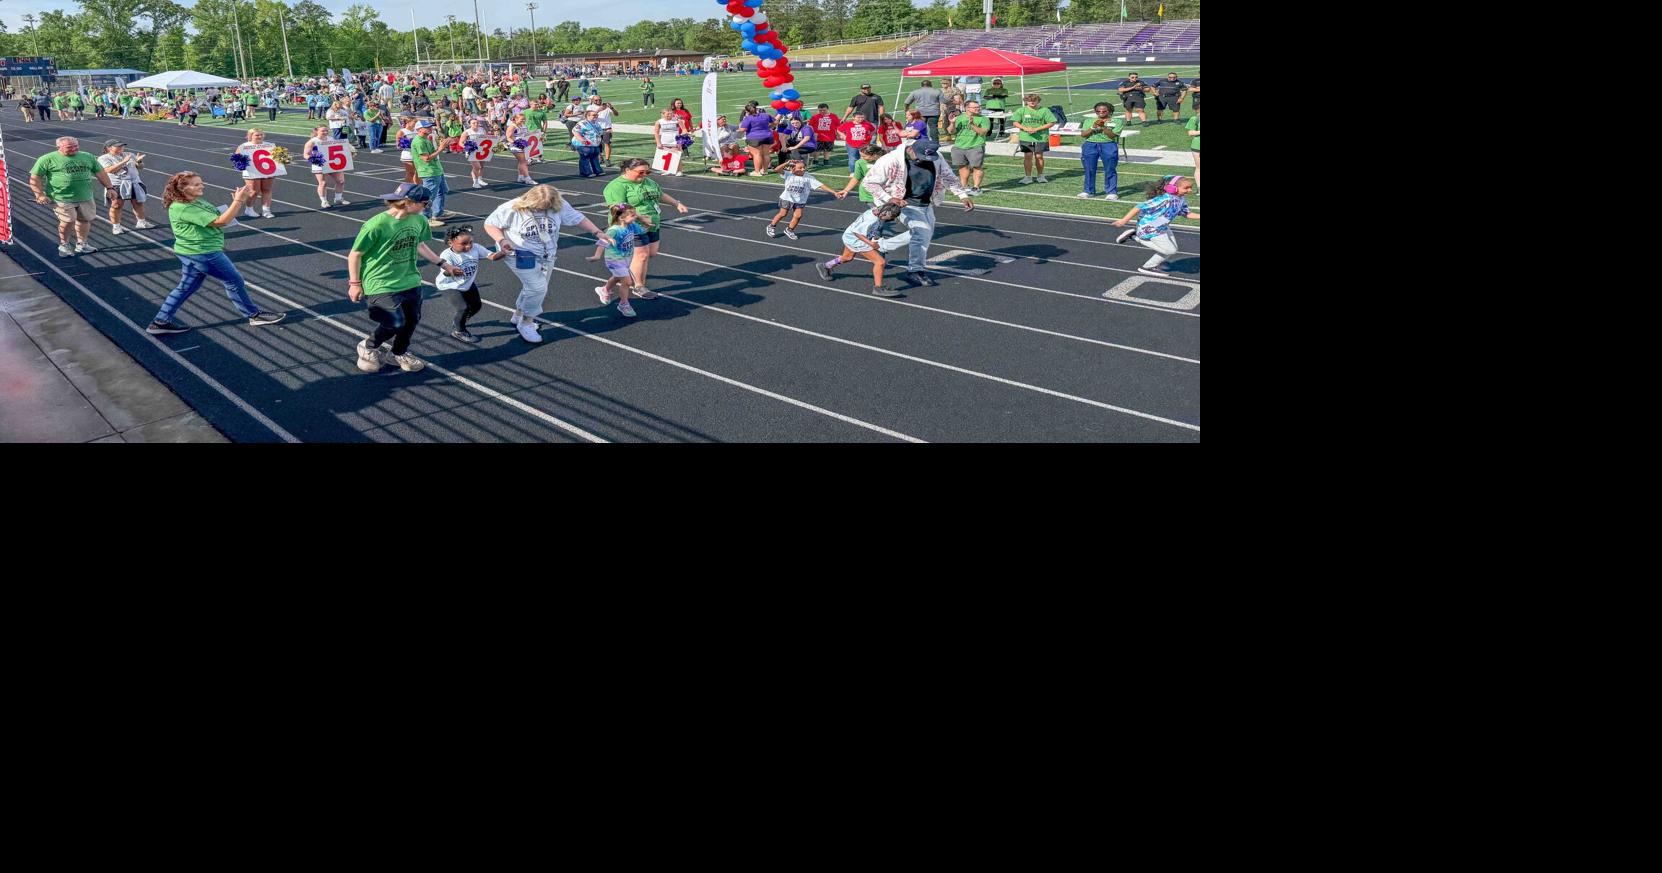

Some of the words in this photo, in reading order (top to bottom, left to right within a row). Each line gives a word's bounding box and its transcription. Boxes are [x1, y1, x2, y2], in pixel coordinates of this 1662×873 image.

[475, 139, 493, 161] 3
[527, 135, 540, 157] 2
[252, 149, 277, 176] 6
[328, 145, 347, 171] 5
[661, 152, 673, 171] 1
